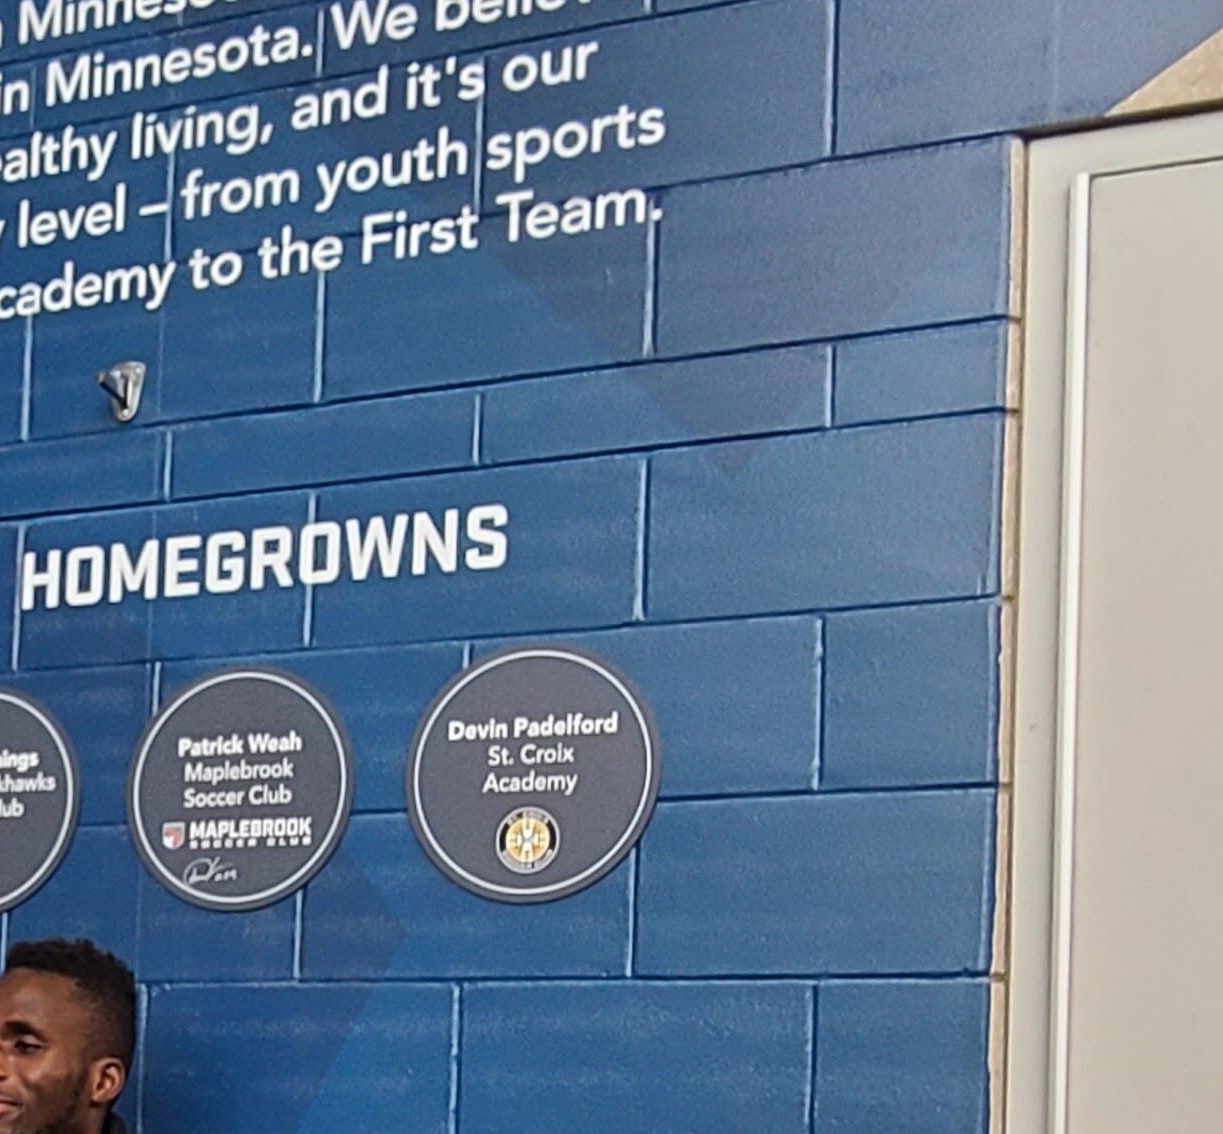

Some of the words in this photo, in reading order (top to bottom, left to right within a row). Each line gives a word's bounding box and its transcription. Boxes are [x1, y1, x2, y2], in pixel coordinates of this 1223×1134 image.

[45, 24, 313, 107] Minnesota.
[331, 0, 418, 50] We
[132, 104, 273, 160] living,
[291, 64, 389, 131] and
[406, 56, 485, 110] it's
[502, 41, 599, 92] our
[17, 183, 126, 248] level
[180, 168, 300, 220] from
[315, 126, 467, 213] youth
[486, 104, 666, 183] sports
[188, 248, 242, 290] to
[258, 225, 343, 279] the
[361, 205, 479, 265] First
[495, 188, 663, 243] Team.
[20, 503, 509, 612] HOMEGROWNS
[448, 718, 508, 741] Devin
[513, 711, 618, 738] Padelford
[178, 734, 244, 757] Patrick
[248, 730, 302, 753] Weah
[488, 746, 514, 766] St.
[520, 742, 574, 764] Croix
[184, 757, 293, 785] Maplebrook
[482, 770, 578, 795] Academy
[184, 788, 244, 808] Soccer
[248, 783, 292, 805] Club
[189, 816, 312, 839] MAPLEBROOK
